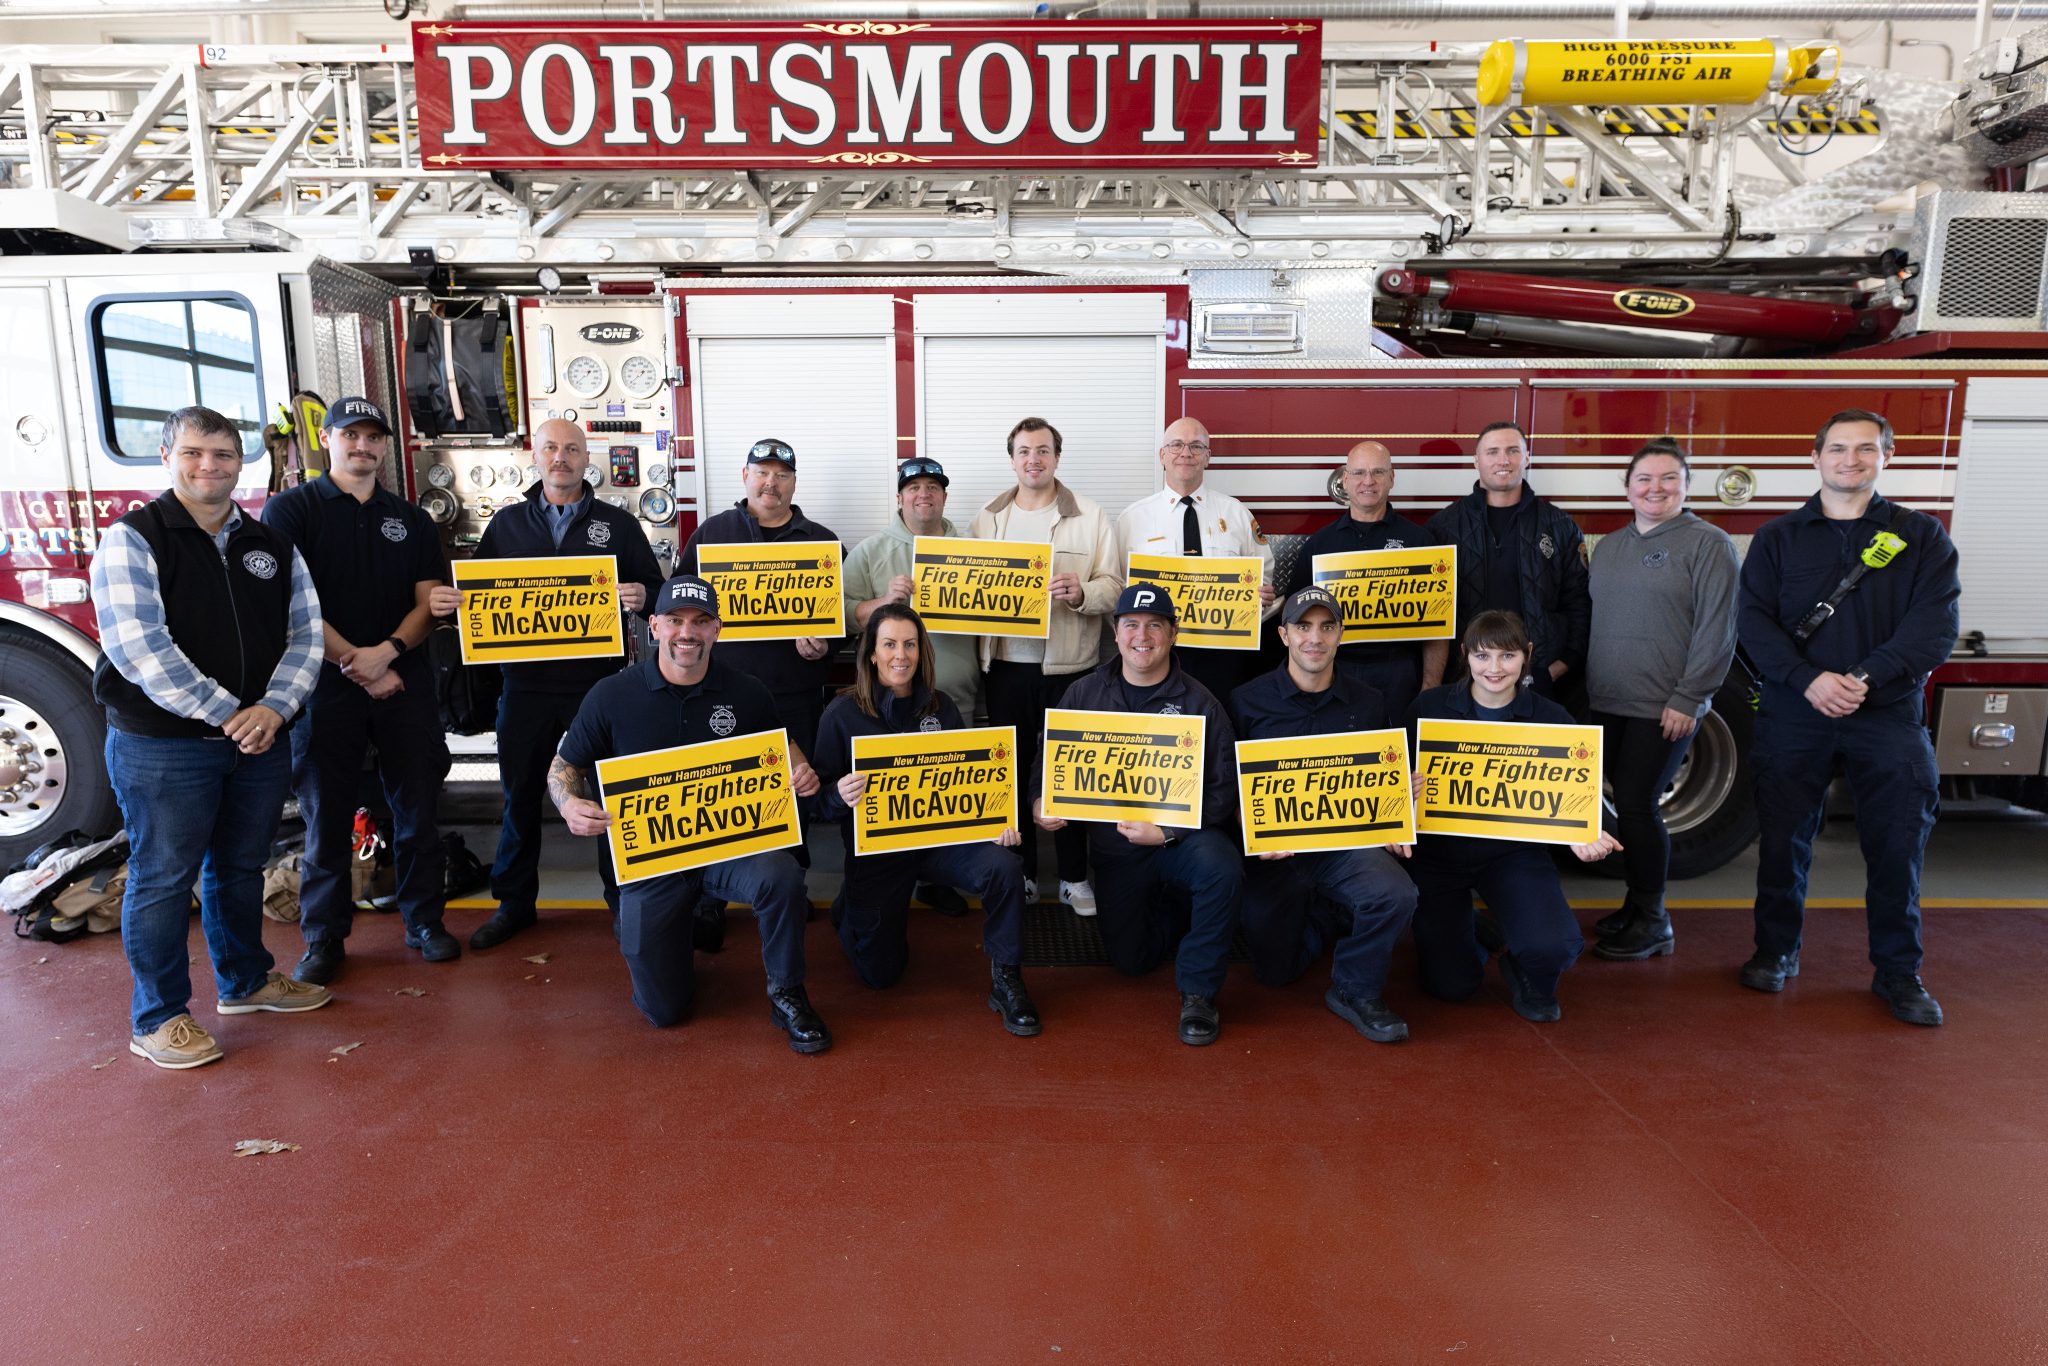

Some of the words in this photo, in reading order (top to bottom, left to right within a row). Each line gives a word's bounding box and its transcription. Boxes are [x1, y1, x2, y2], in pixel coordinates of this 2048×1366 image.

[206, 48, 227, 60] 92
[1564, 42, 1618, 51] HIGH
[1628, 41, 1736, 51] PRESSURE
[1606, 53, 1649, 65] 6000
[1660, 53, 1693, 65] PSI
[1561, 68, 1685, 82] BREATHING
[1695, 67, 1733, 80] AIR
[436, 42, 1299, 146] PORTSMOUTH
[1627, 294, 1682, 311] E-ONE
[588, 327, 632, 339] E-ONE
[345, 404, 381, 419] FIRE
[28, 500, 112, 518] CITY
[732, 562, 751, 571] New
[752, 561, 797, 571] Hampshire
[945, 556, 963, 565] New
[965, 557, 1009, 567] Hampshire
[1345, 570, 1363, 578] New
[1365, 567, 1410, 577] Hampshire
[494, 579, 515, 588] New
[518, 577, 567, 587] Hampshire
[672, 582, 708, 592] PORTSMOUTH
[710, 575, 747, 591] Fire
[755, 573, 834, 594] Fighters
[921, 566, 958, 584] Fire
[965, 569, 1044, 590] Fighters
[1158, 571, 1176, 580] New
[1177, 573, 1219, 583] Hampshire
[672, 588, 708, 602] FIRE
[920, 584, 931, 608] FOR
[1133, 590, 1156, 608] P
[1177, 584, 1254, 604] Fighters
[1297, 593, 1330, 605] FIRE
[1324, 582, 1359, 598] Fire
[1367, 578, 1448, 599] Fighters
[468, 592, 512, 610] Fire
[521, 590, 610, 611] Fighters
[729, 593, 816, 618] McAvoy
[938, 586, 1024, 617] McAvoy
[1341, 598, 1428, 621] McAvoy
[470, 613, 483, 638] FOR
[492, 611, 591, 636] McAvoy
[1174, 602, 1235, 629] cAvoy
[1082, 732, 1101, 742] New
[1104, 733, 1153, 744] Hampshire
[893, 757, 914, 767] New
[916, 752, 966, 765] Hampshire
[1054, 743, 1097, 764] Fire
[1104, 746, 1194, 771] Fighters
[1457, 742, 1480, 753] New
[1482, 743, 1540, 757] Hampshire
[1277, 760, 1299, 770] New
[1301, 755, 1354, 768] Hampshire
[1427, 755, 1474, 777] Fire
[1483, 758, 1591, 784] Fighters
[648, 774, 672, 787] New
[675, 763, 732, 782] Hampshire
[865, 772, 910, 793] Fire
[918, 766, 1008, 791] Fighters
[1054, 764, 1066, 791] FOR
[1074, 766, 1172, 802] McAvoy
[1251, 775, 1296, 796] Fire
[1305, 769, 1400, 795] Fighters
[619, 793, 670, 819] Fire
[680, 772, 782, 807] Fighters
[1426, 777, 1439, 805] FOR
[1449, 779, 1564, 818] McAvoy
[866, 795, 879, 825] FOR
[889, 791, 987, 821] McAvoy
[1253, 797, 1266, 826] FOR
[1274, 794, 1380, 823] McAvoy
[647, 802, 762, 844] McAvoy
[622, 819, 639, 851] FOR
